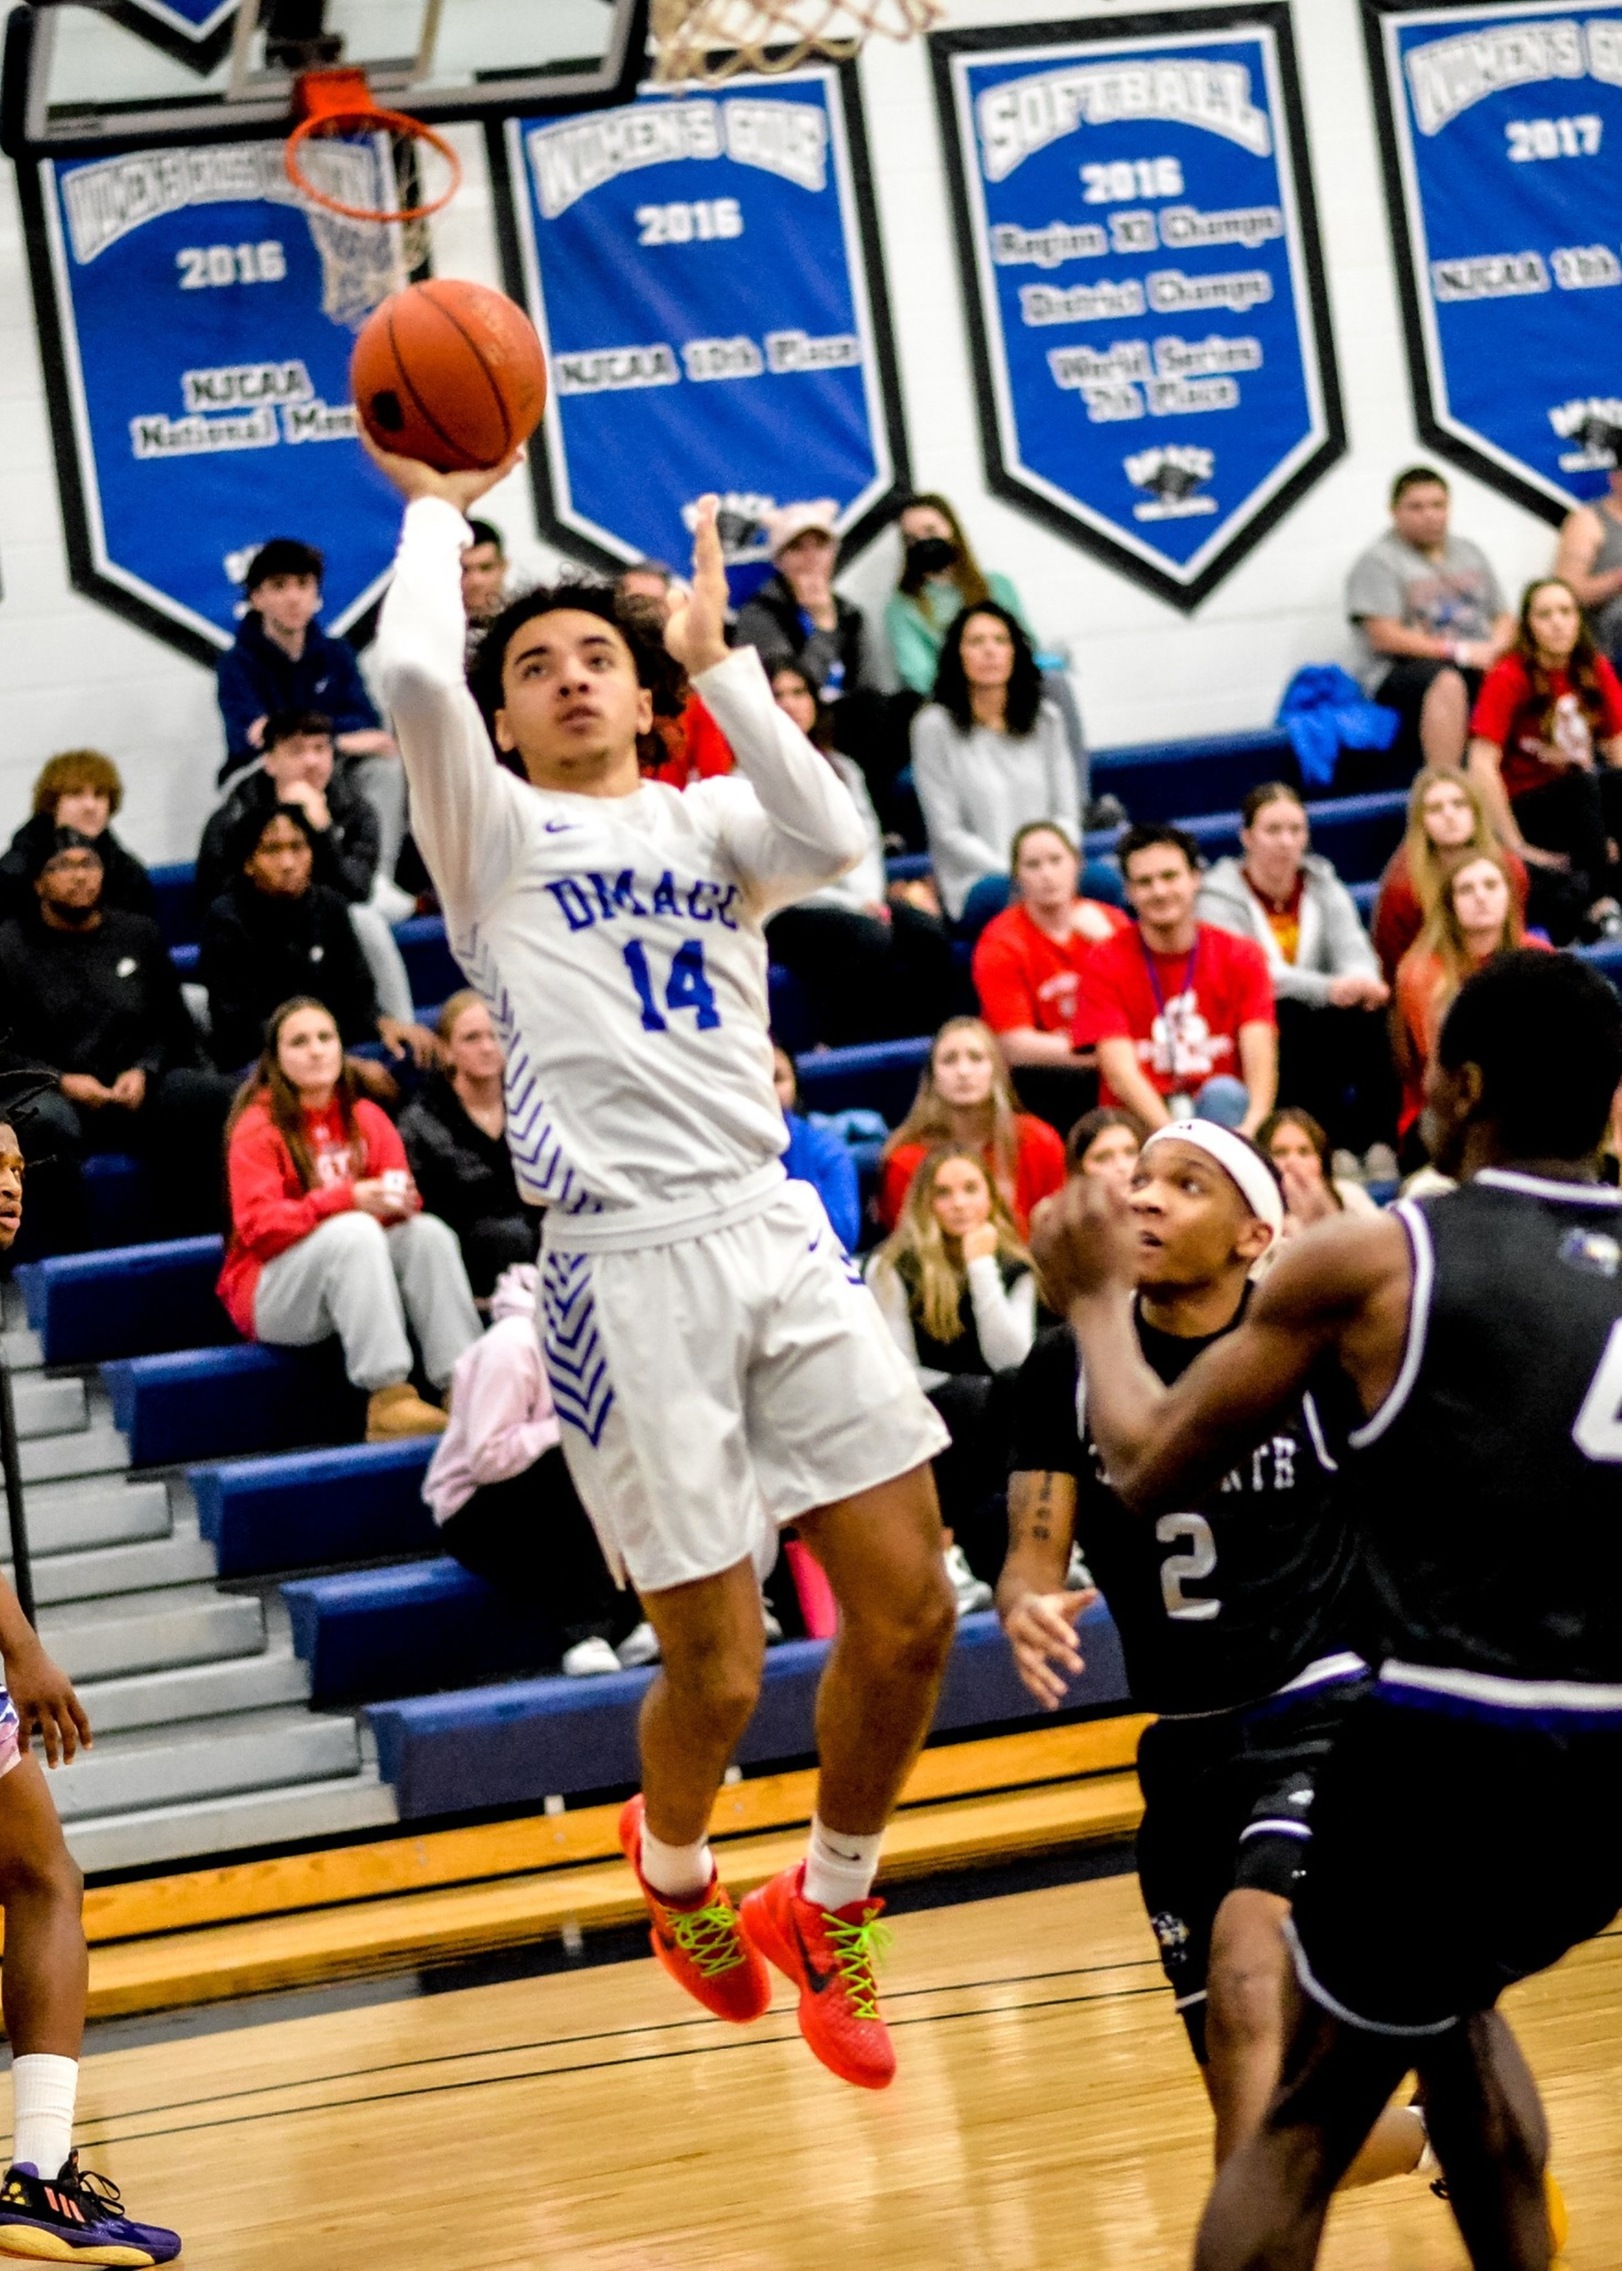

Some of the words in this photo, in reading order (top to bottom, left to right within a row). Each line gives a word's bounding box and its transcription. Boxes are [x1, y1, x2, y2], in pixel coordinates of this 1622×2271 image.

[980, 62, 1269, 179] SOFTBALL
[1506, 116, 1602, 161] 2017
[1081, 158, 1183, 203] 2016
[636, 200, 742, 245] 2016
[177, 242, 285, 289] 2016
[186, 363, 312, 410] NJCAA
[558, 347, 676, 392] NJCAA
[623, 939, 721, 1031] 14
[1156, 1512, 1221, 1619] 2
